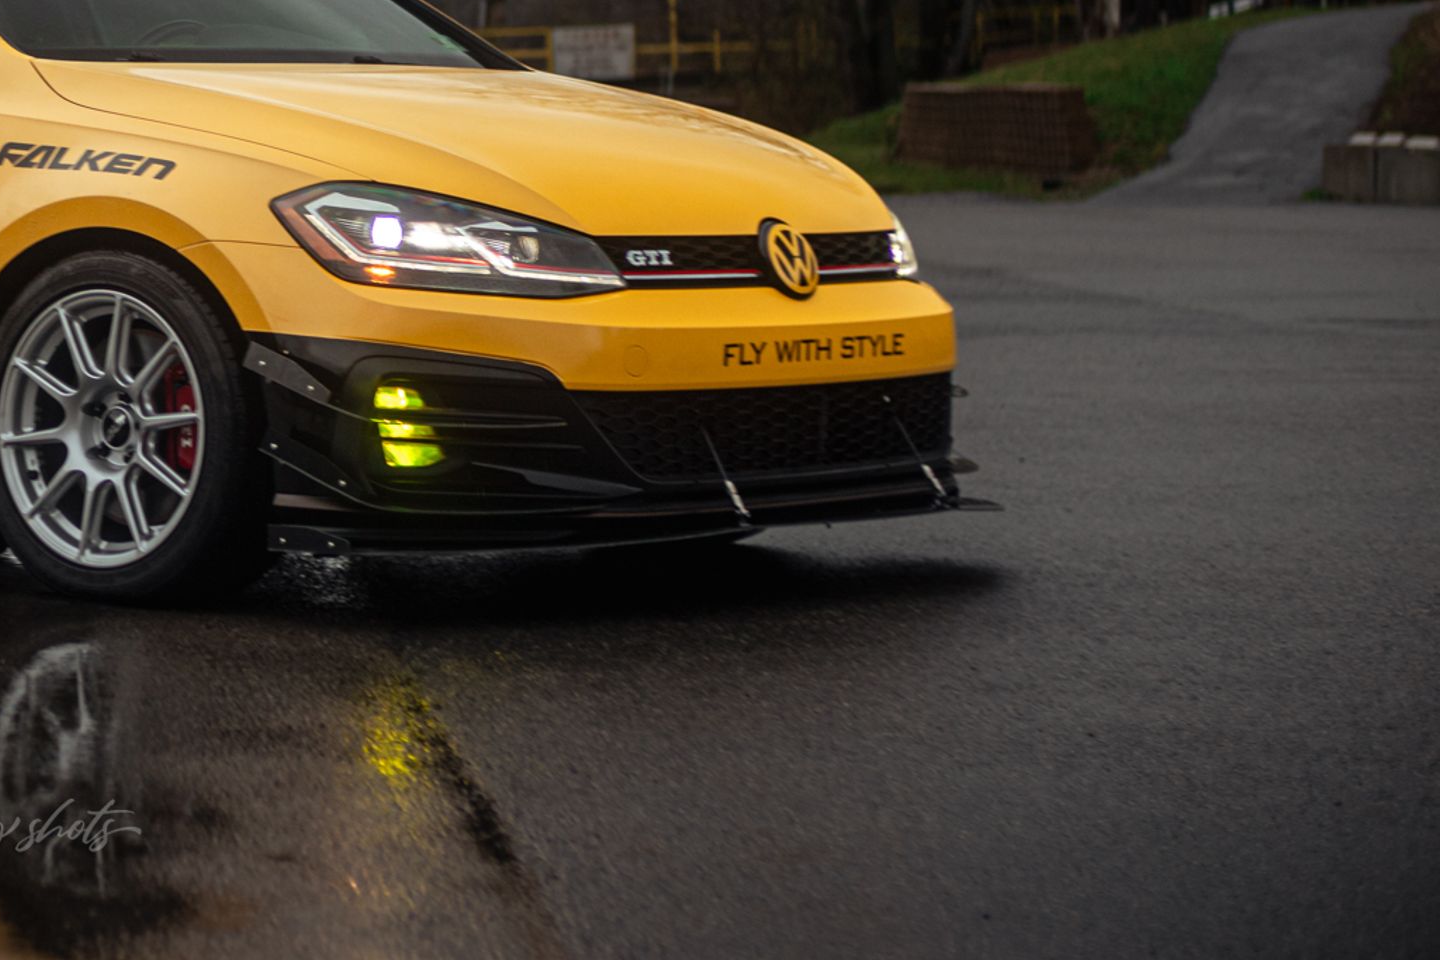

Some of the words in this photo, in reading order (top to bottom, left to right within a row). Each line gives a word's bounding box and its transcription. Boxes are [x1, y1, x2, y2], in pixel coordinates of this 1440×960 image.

[626, 249, 672, 266] GTI
[723, 342, 766, 366] FLY
[775, 337, 832, 363] WITH
[841, 334, 904, 359] STYLE
